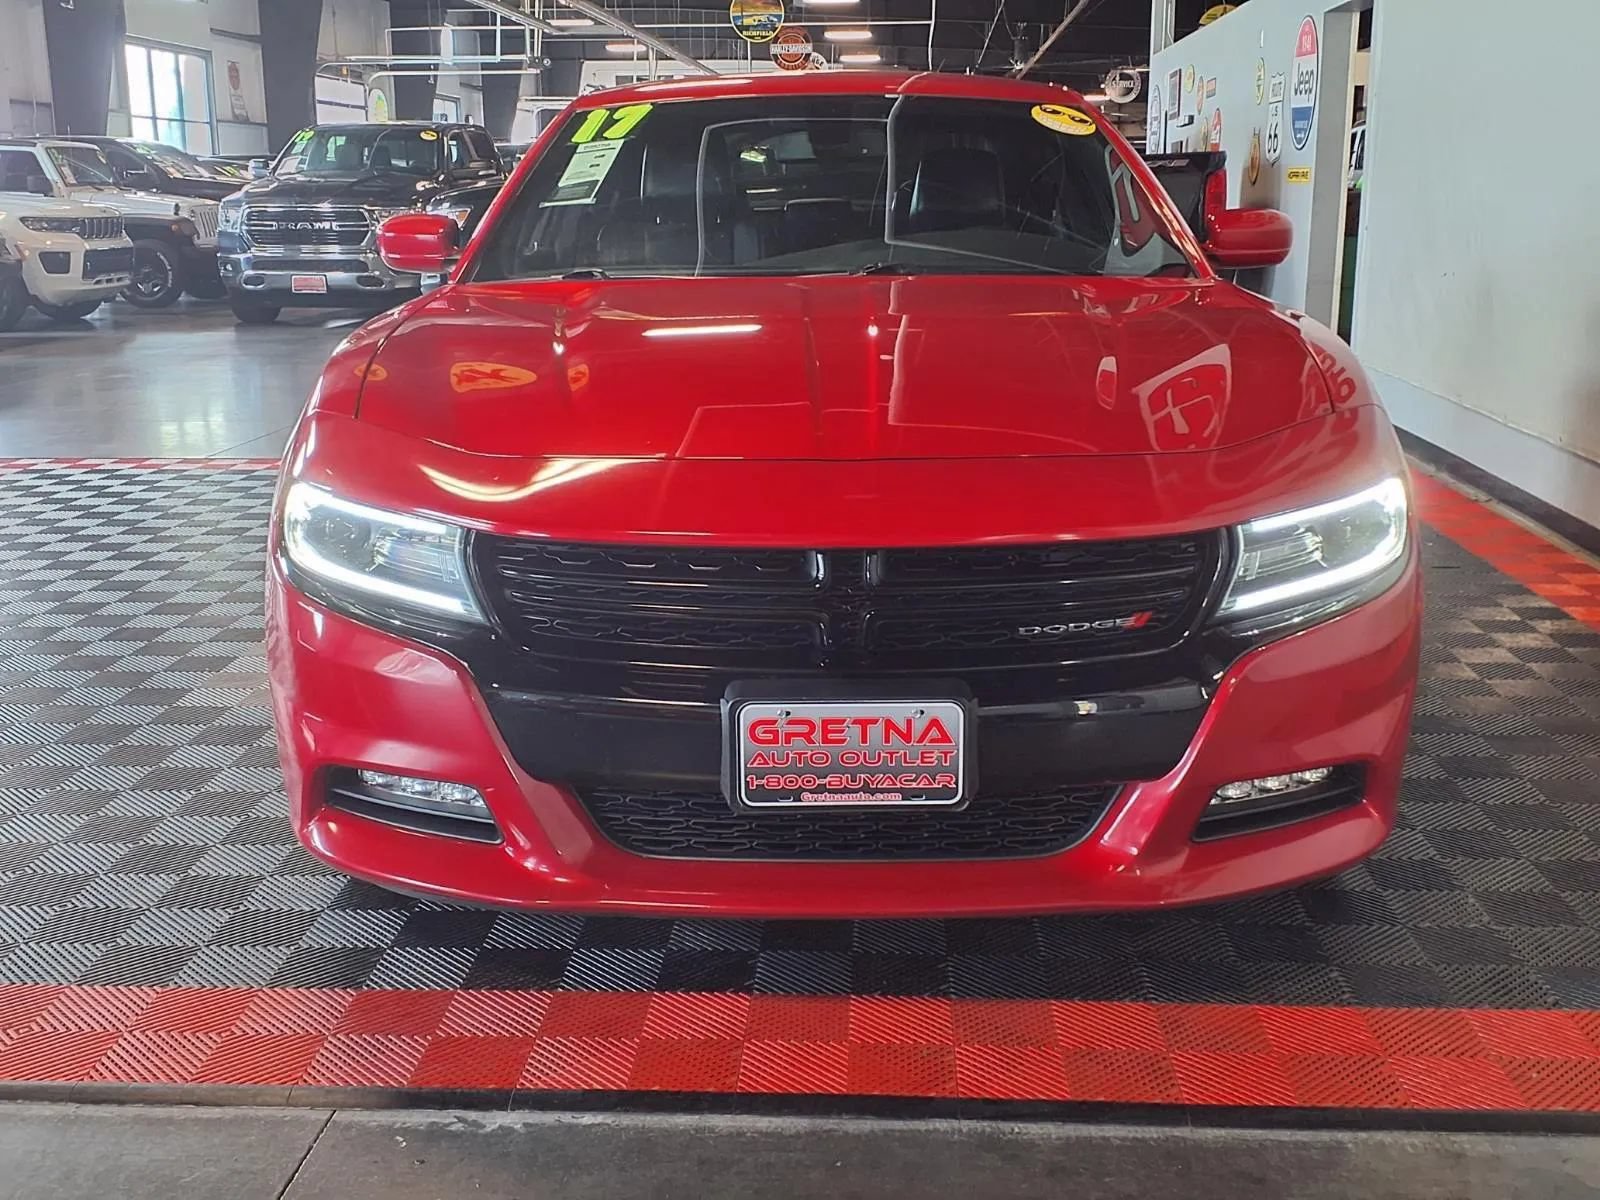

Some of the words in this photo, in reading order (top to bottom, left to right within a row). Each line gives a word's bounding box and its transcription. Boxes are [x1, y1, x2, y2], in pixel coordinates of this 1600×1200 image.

[1111, 80, 1134, 88] SERVICE
[1294, 62, 1315, 103] Jeep
[571, 103, 653, 143] 17
[1267, 121, 1279, 154] 66
[1018, 616, 1136, 635] DODGE
[748, 715, 956, 746] GRETNA
[747, 750, 831, 767] AUTO
[839, 750, 957, 767] OUTLET
[747, 773, 957, 789] 1-800-BUYACAR
[800, 791, 902, 801] Gretnaauto.com
